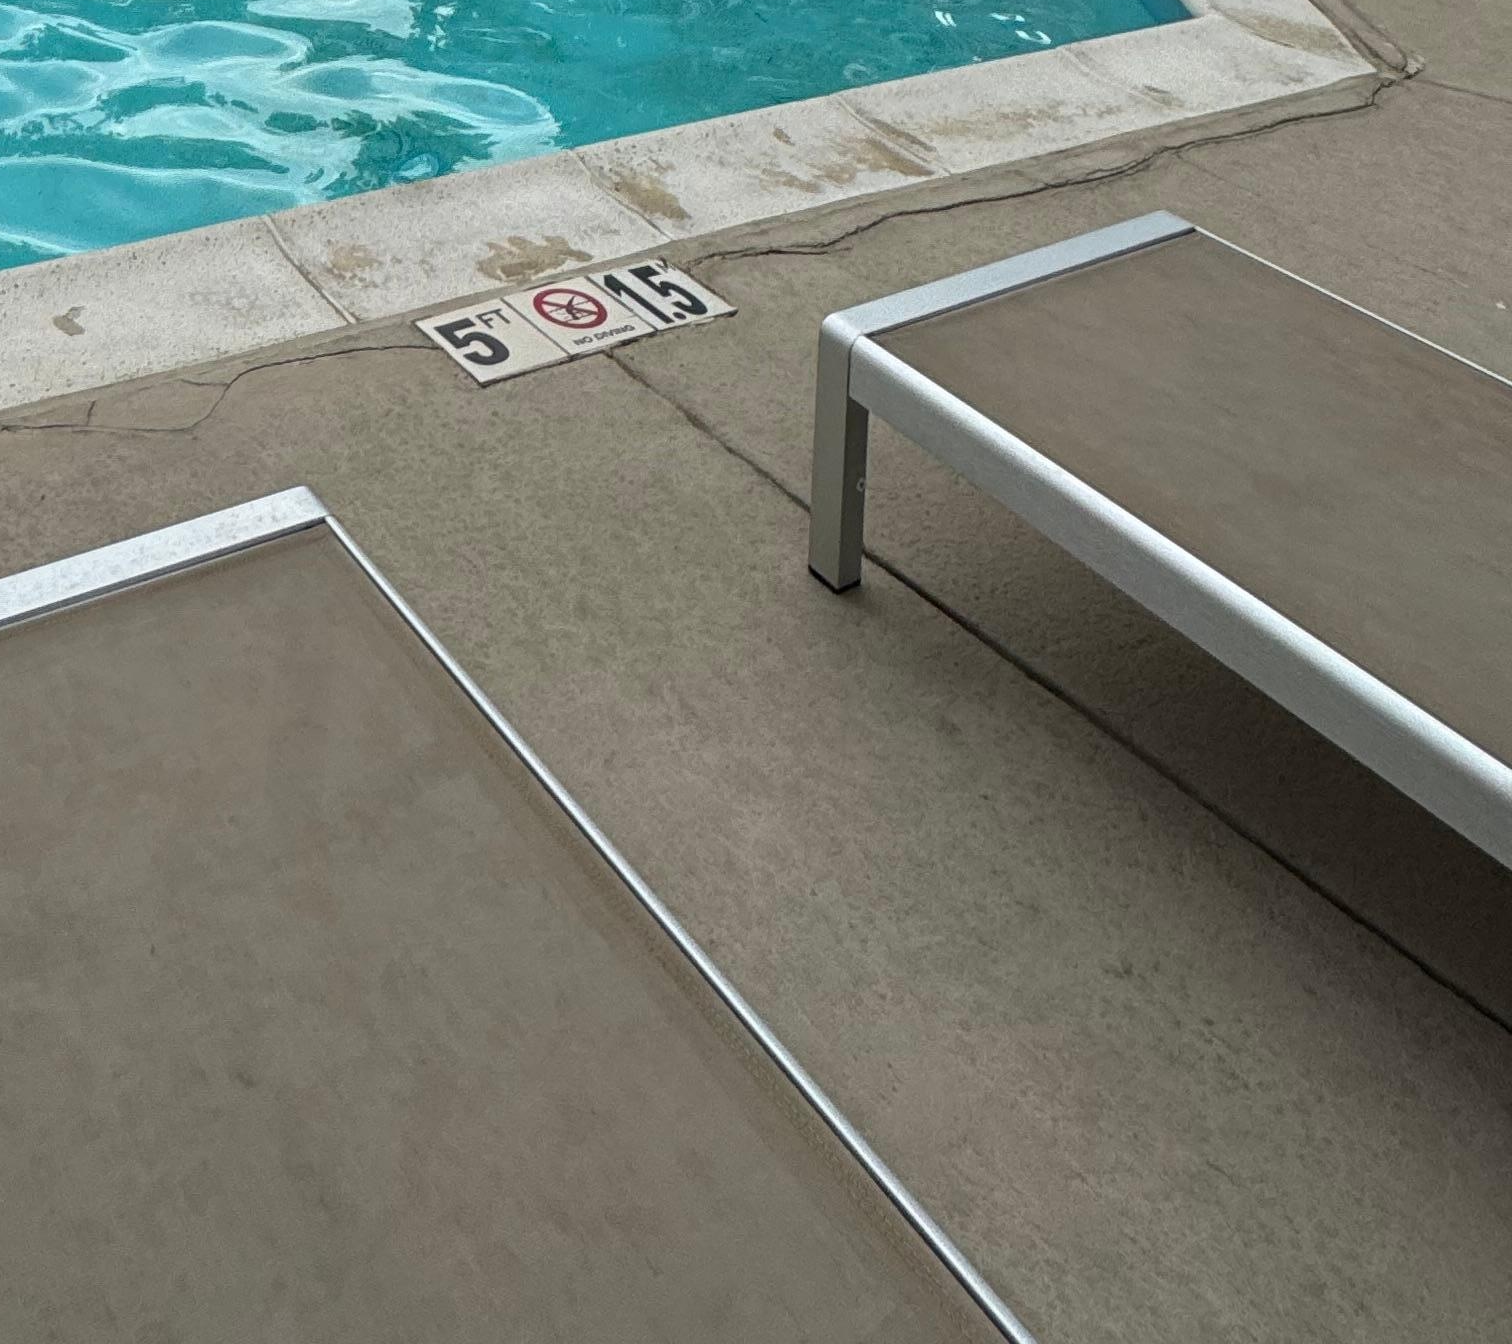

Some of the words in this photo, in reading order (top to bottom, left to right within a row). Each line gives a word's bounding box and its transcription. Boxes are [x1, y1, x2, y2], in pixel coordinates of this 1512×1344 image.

[603, 264, 709, 324] 1.5
[434, 317, 511, 366] 5
[475, 308, 511, 330] FT
[573, 335, 594, 347] NO
